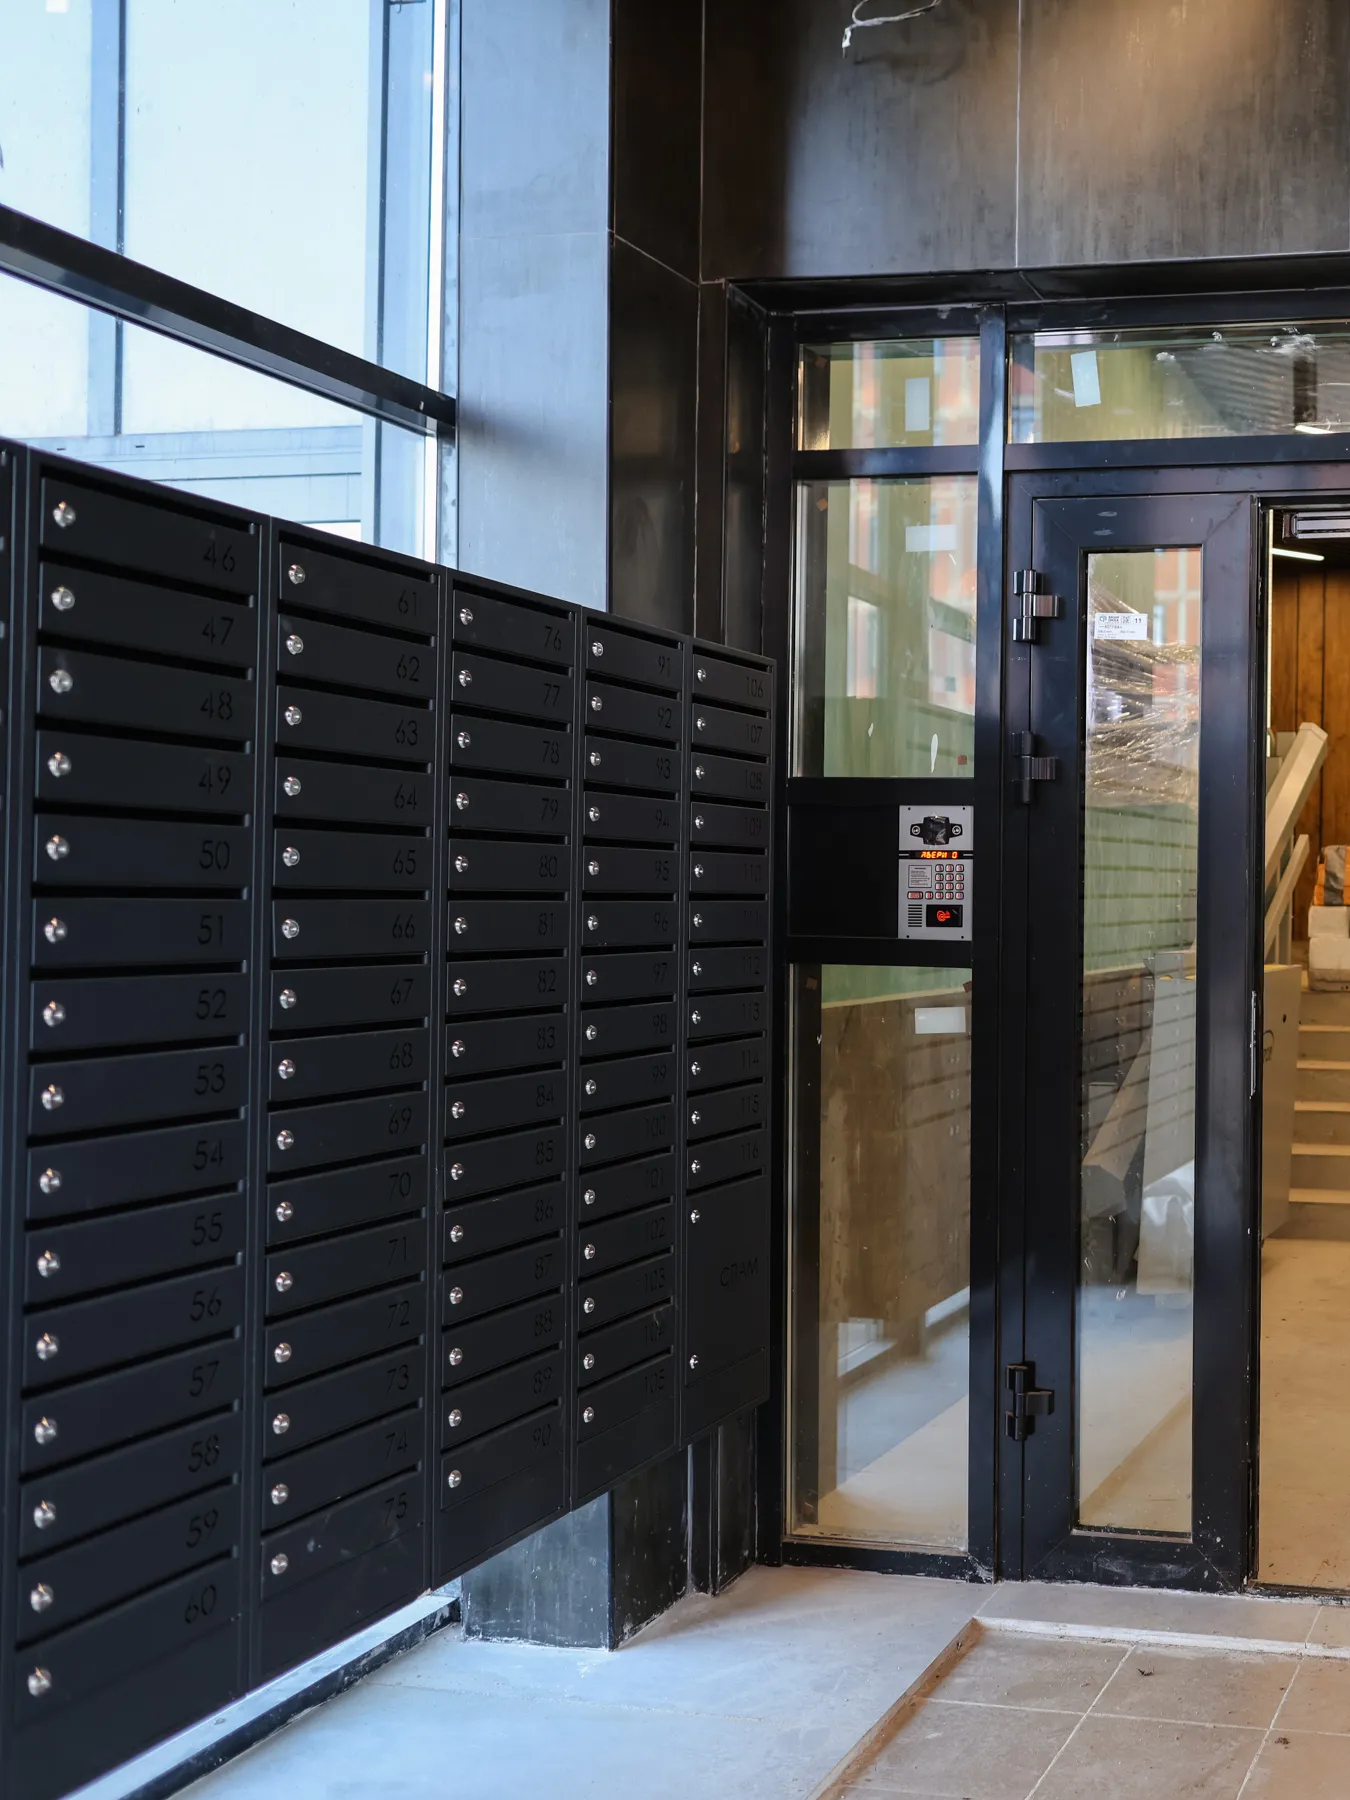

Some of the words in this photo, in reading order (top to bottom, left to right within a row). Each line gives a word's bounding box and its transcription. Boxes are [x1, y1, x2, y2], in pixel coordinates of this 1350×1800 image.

[203, 541, 237, 573] 46
[398, 590, 417, 617] 61
[202, 616, 234, 645] 47
[544, 626, 561, 650] 76
[397, 655, 418, 682] 62
[658, 656, 672, 677] 91
[201, 692, 233, 722] 48
[543, 683, 561, 706] 77
[396, 719, 418, 745] 63
[658, 708, 671, 729] 92
[542, 741, 559, 764] 78
[200, 765, 231, 795] 49
[657, 758, 671, 779] 93
[394, 784, 417, 811] 64
[541, 798, 558, 821] 79
[200, 840, 230, 871] 50
[393, 850, 416, 875] 65
[540, 855, 557, 878] 80
[655, 861, 669, 882] 95
[198, 915, 224, 946] 51
[392, 914, 415, 939] 66
[539, 913, 555, 936] 81
[654, 911, 667, 932] 96
[538, 969, 555, 992] 82
[654, 960, 668, 983] 97
[196, 988, 227, 1020] 52
[391, 978, 413, 1004] 67
[653, 1013, 667, 1034] 98
[537, 1026, 554, 1049] 83
[390, 1043, 413, 1070] 68
[194, 1063, 225, 1095] 53
[653, 1064, 667, 1084] 99
[536, 1084, 554, 1107] 84
[389, 1108, 412, 1134] 69
[193, 1139, 223, 1171] 54
[536, 1140, 553, 1165] 85
[388, 1172, 411, 1202] 70
[535, 1195, 553, 1222] 86
[190, 1213, 223, 1245] 55
[387, 1237, 407, 1266] 71
[535, 1254, 551, 1278] 87
[720, 1258, 758, 1288] СПАМ
[190, 1286, 222, 1321] 56
[388, 1302, 410, 1329] 72
[534, 1310, 552, 1335] 88
[188, 1361, 219, 1396] 57
[386, 1364, 409, 1397] 73
[534, 1368, 551, 1393] 89
[386, 1428, 408, 1461] 74
[533, 1423, 551, 1451] 90
[188, 1436, 219, 1473] 58
[385, 1492, 408, 1526] 75
[186, 1508, 218, 1549] 59
[185, 1584, 216, 1624] 60
